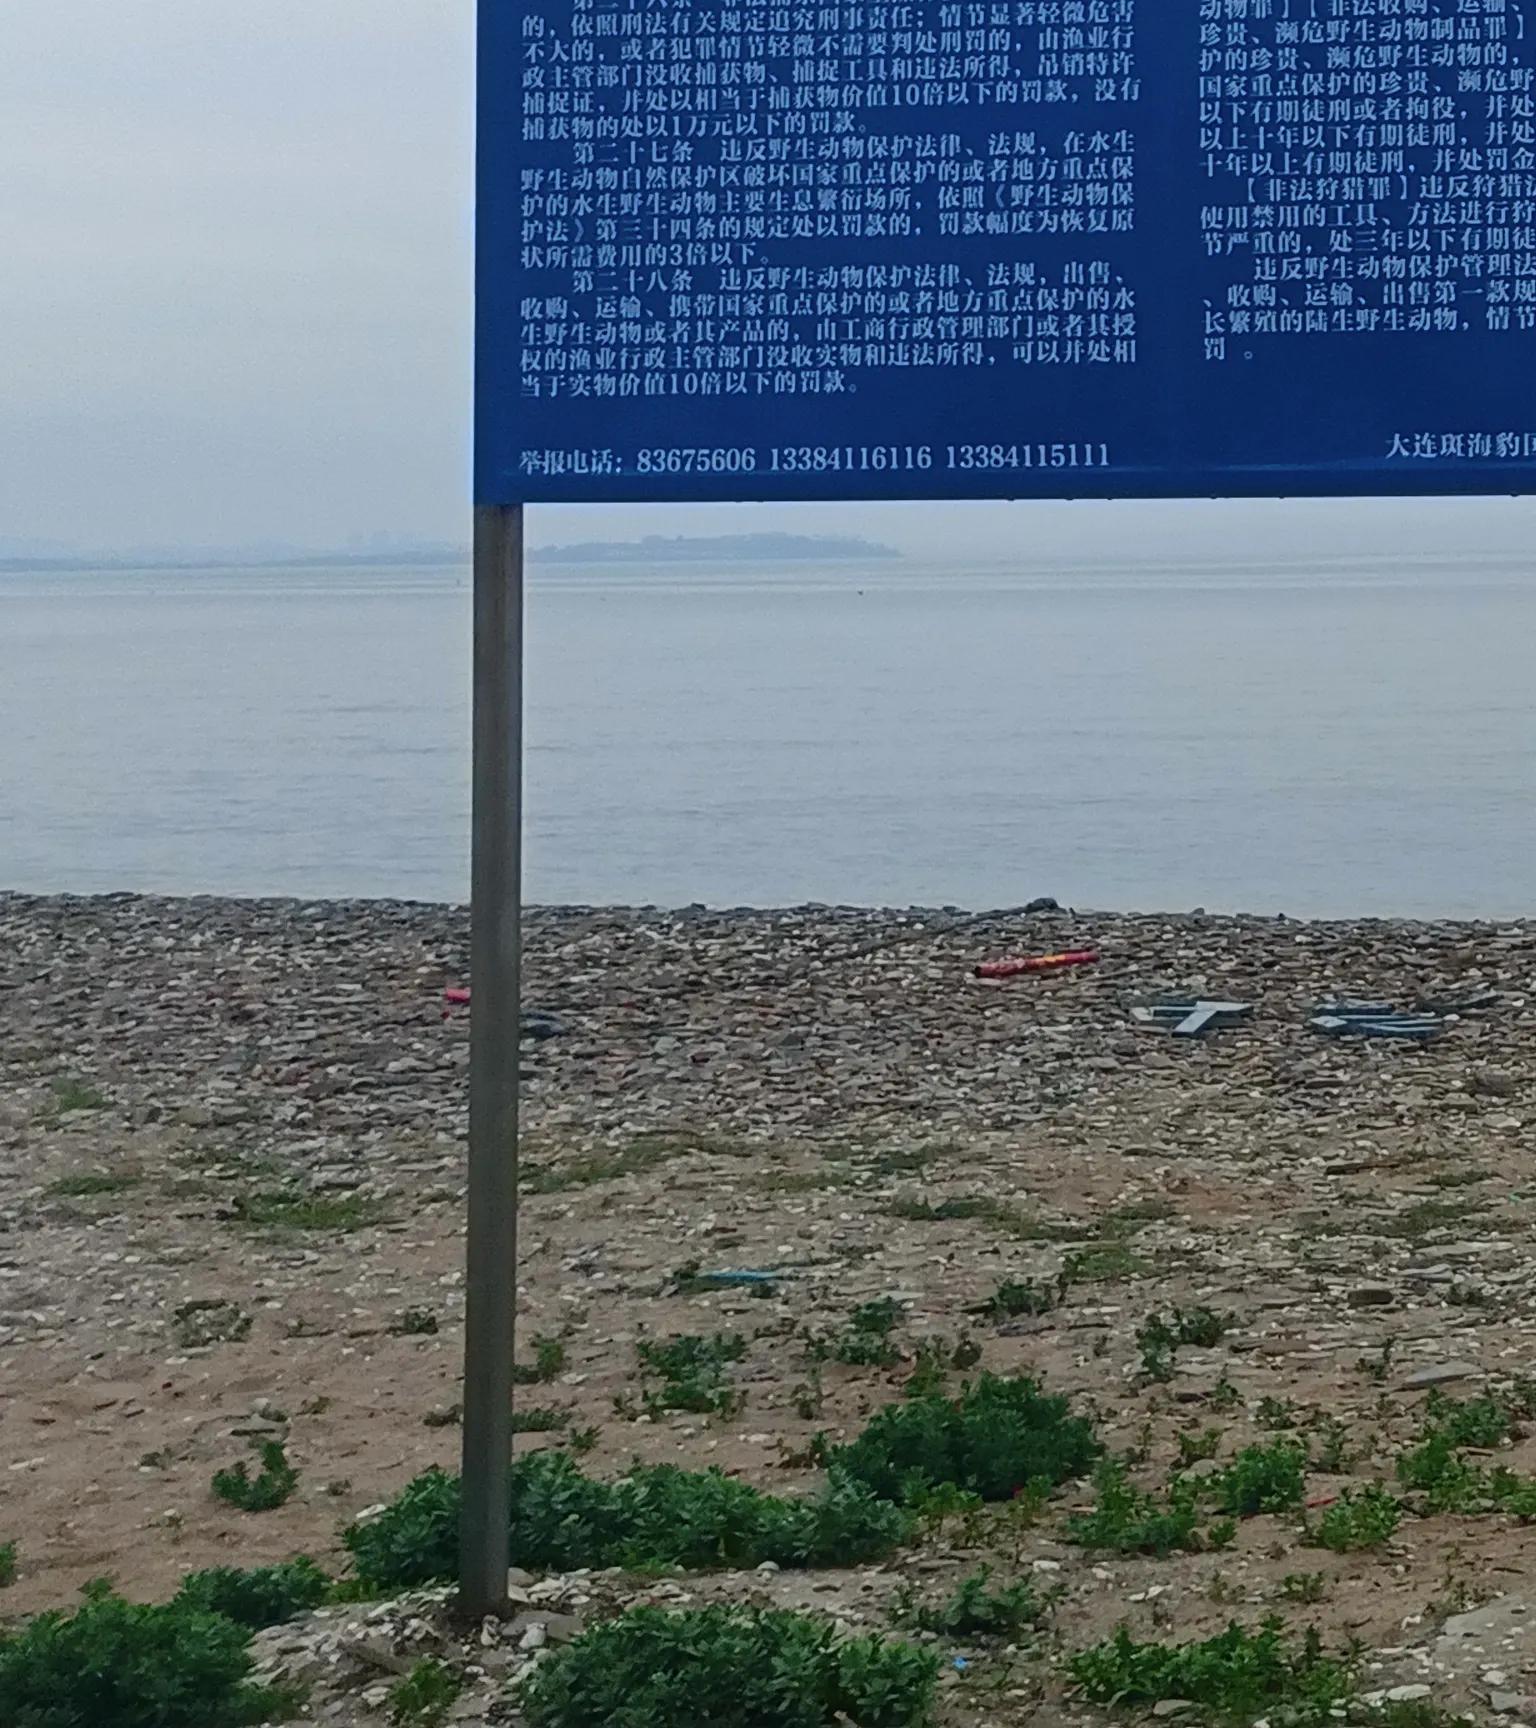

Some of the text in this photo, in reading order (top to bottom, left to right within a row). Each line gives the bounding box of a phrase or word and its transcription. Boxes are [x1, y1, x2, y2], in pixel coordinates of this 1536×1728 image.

[572, 141, 694, 165] 第二十七条
[572, 270, 693, 293] 第二十八条
[518, 443, 1111, 476] 举报电话： 83675606 13384116116 13384115111
